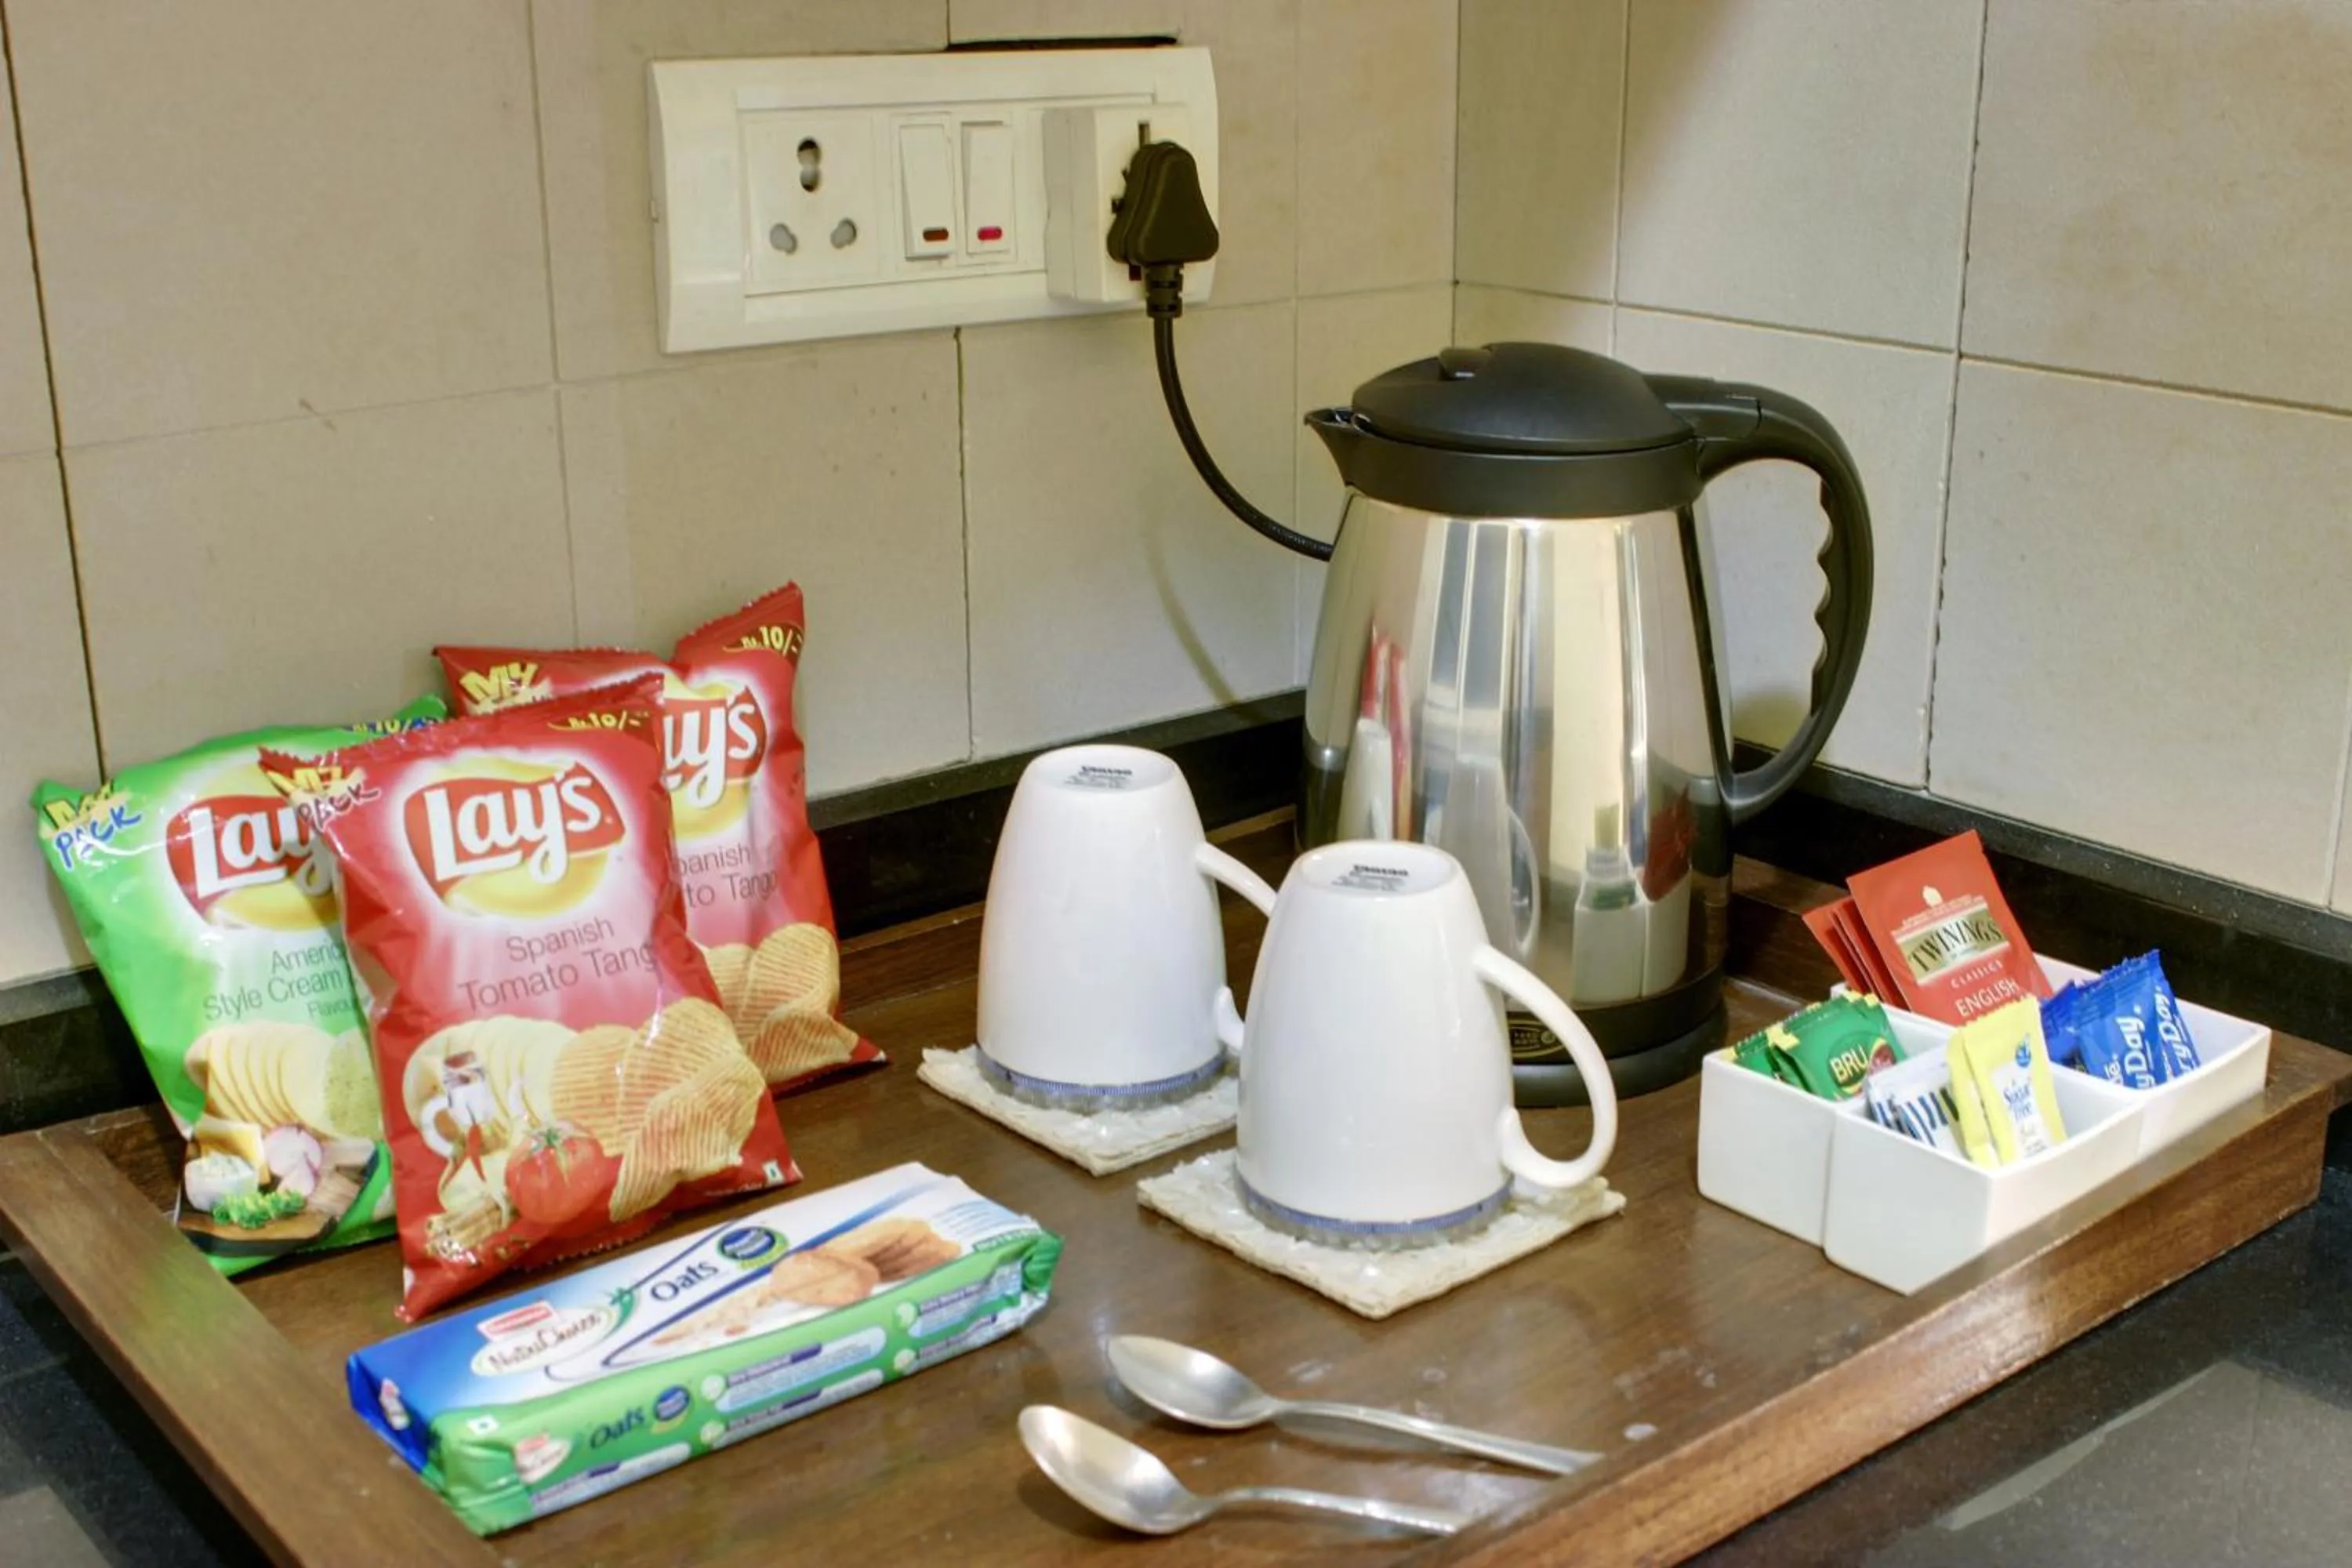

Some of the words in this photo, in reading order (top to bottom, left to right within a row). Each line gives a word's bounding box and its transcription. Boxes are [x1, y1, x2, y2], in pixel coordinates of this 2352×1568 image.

[662, 691, 757, 809] y's
[423, 762, 601, 884] Lay's
[188, 806, 333, 900] Lay
[678, 843, 751, 876] panish
[271, 939, 342, 974] Americ
[506, 916, 615, 964] Spanish
[1907, 918, 2005, 973] TWININGS
[202, 985, 263, 1021] Style
[267, 968, 343, 1004] Cream
[457, 963, 579, 1011] Tomato
[582, 941, 657, 978] Tang
[1954, 977, 2020, 1018] ENGLISH
[2116, 1015, 2156, 1089] yDay
[2154, 991, 2195, 1073] ryDay
[1829, 1043, 1869, 1084] BRU
[650, 1261, 719, 1302] Oats
[589, 1406, 646, 1450] Oats
